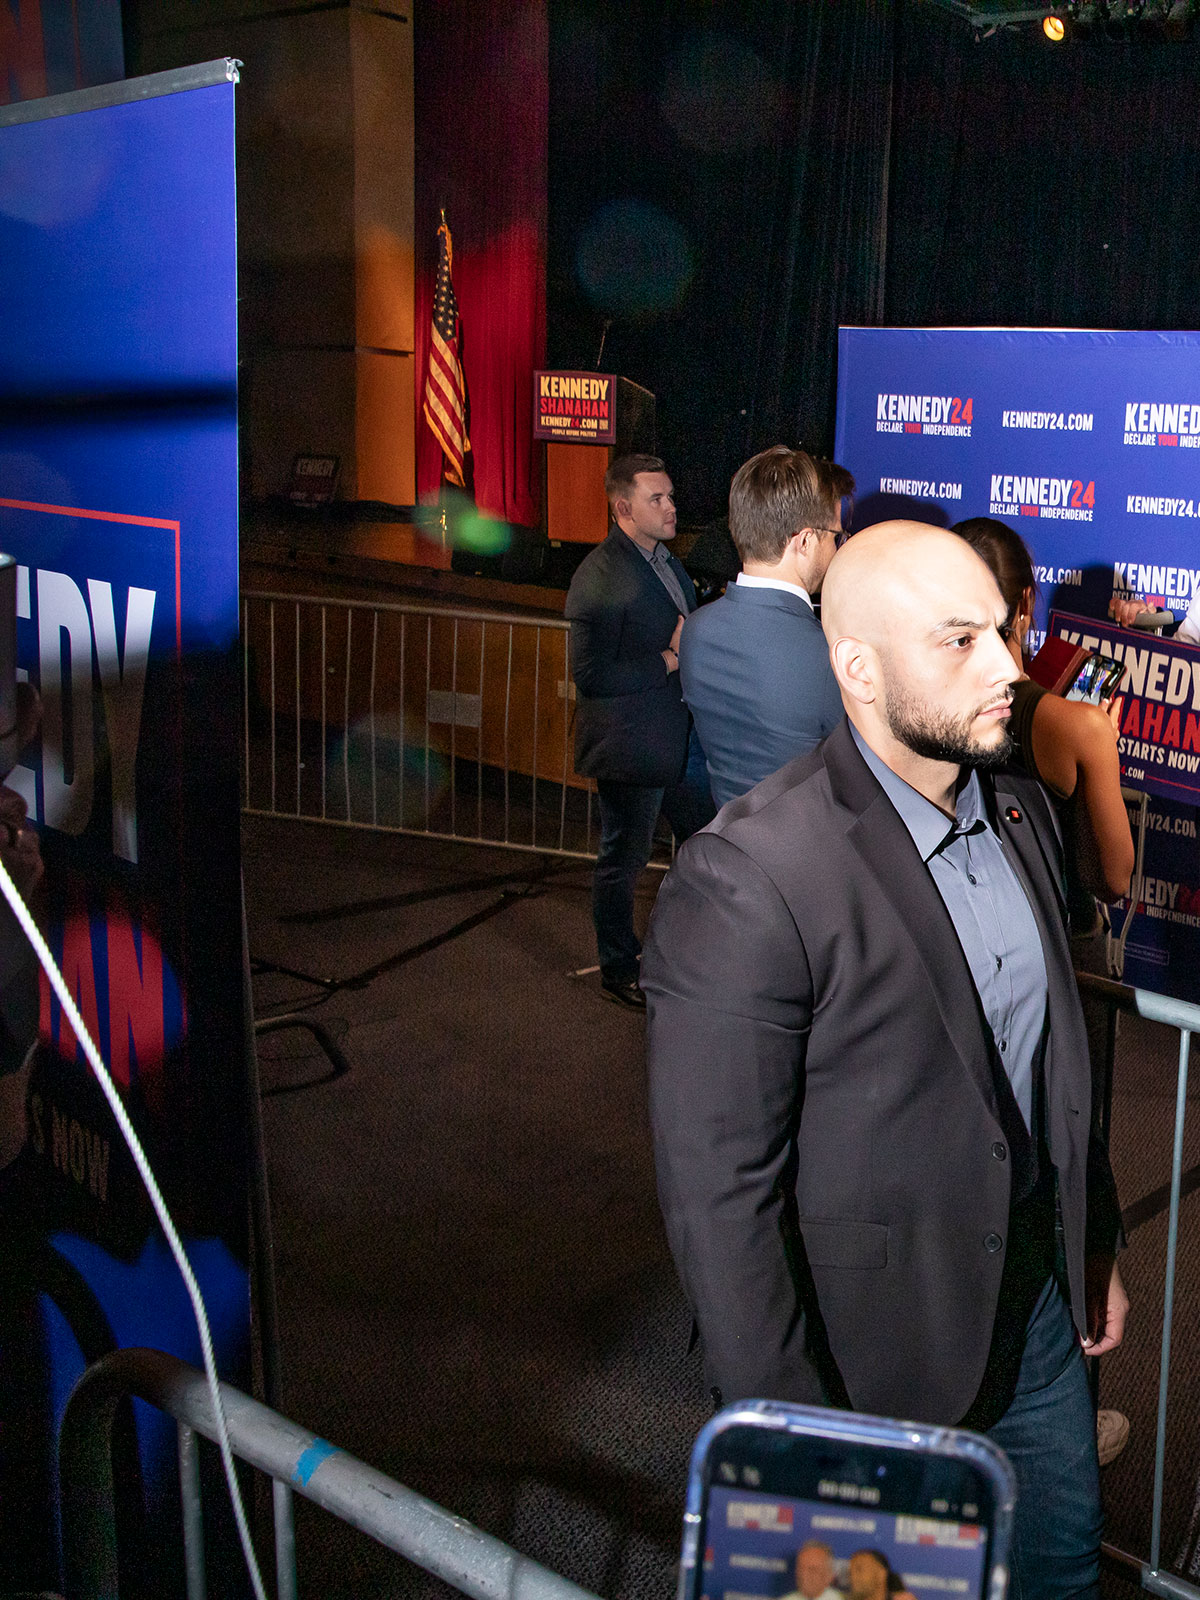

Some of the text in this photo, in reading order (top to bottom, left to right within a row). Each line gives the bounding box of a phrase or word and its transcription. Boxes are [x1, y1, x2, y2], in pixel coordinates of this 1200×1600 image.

[540, 375, 609, 401] KENNEDY
[540, 397, 609, 418] SHANAHAN
[876, 393, 974, 425] KENNEDY24
[540, 415, 598, 430] KENNEDY24.COM
[876, 420, 972, 437] DECLARE YOUR INDEPENDENCE
[1002, 410, 1094, 432] KENNEDY24.COM
[1123, 432, 1156, 446] DECLARE
[1157, 434, 1178, 447] YOUR
[879, 477, 962, 500] KENNEDY24.COM
[990, 474, 1096, 509] KENNEDY24
[989, 502, 1093, 522] DECLARE YOUR INDEPENDENCE
[1118, 736, 1165, 764] STARTS
[1167, 749, 1200, 774] NOW
[1146, 904, 1200, 928] INDEPENDENCE
